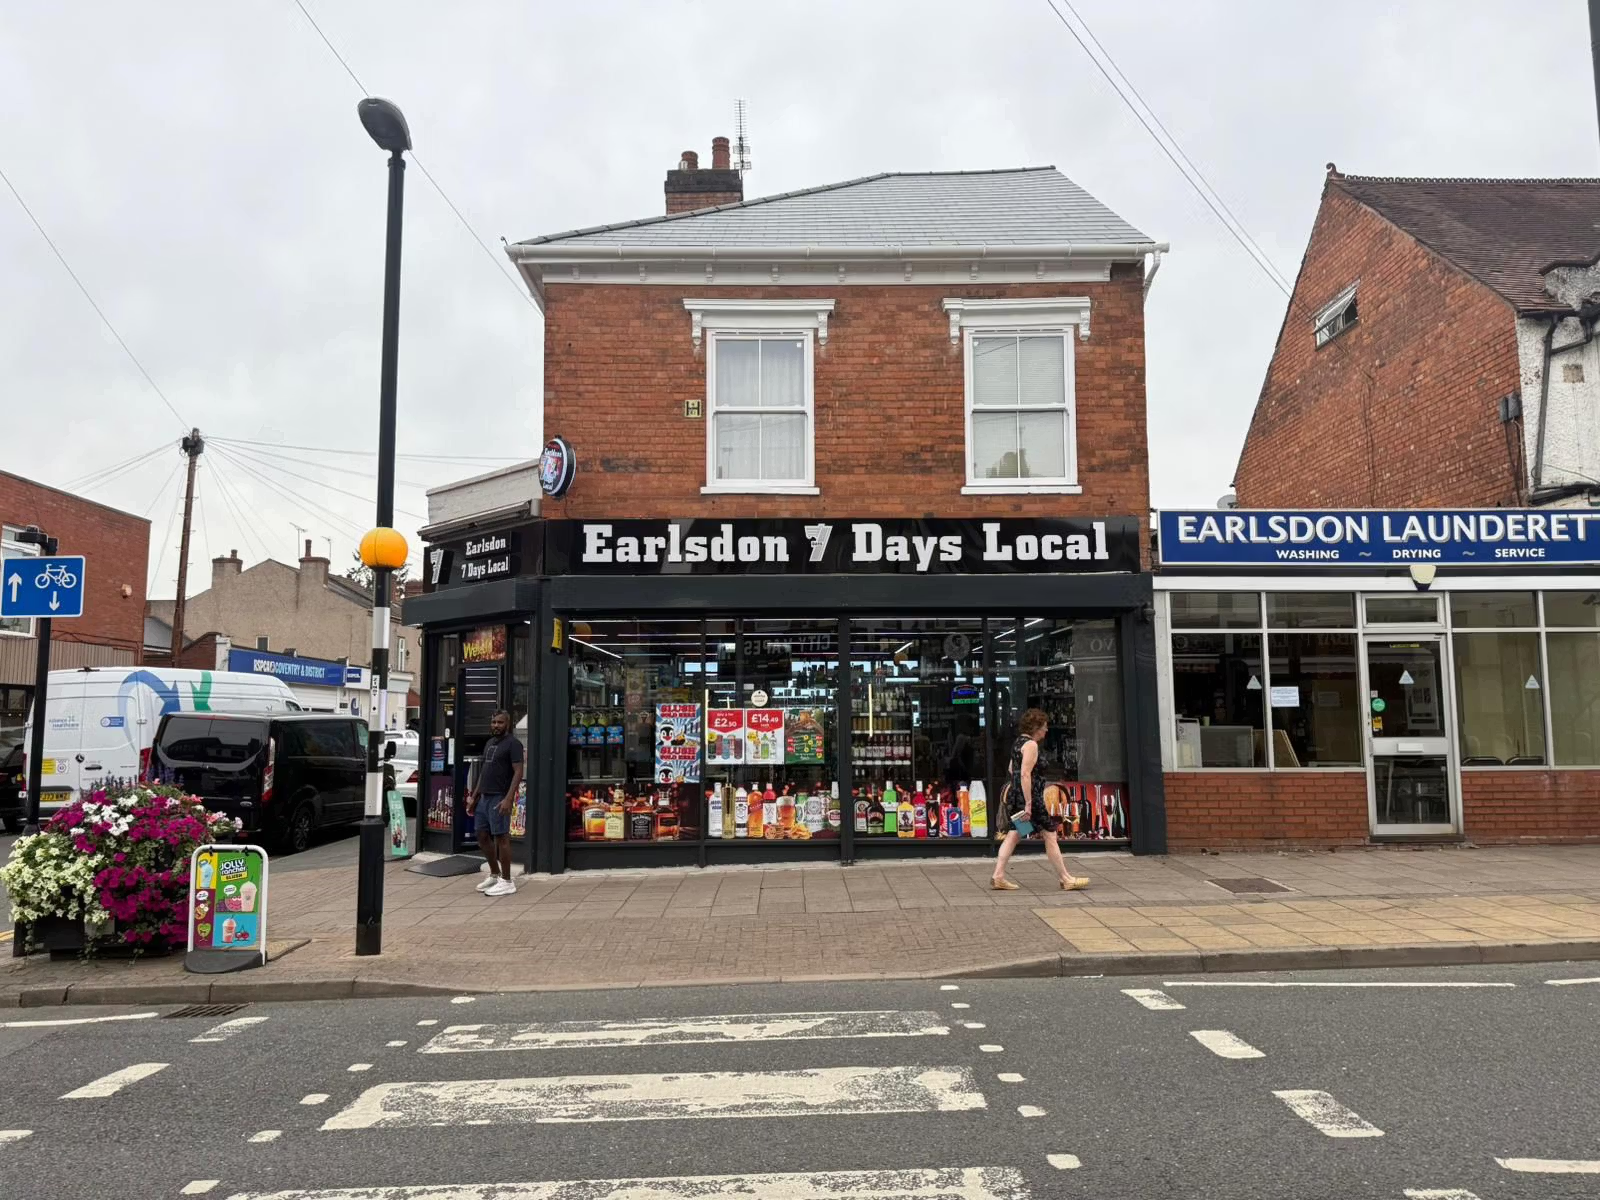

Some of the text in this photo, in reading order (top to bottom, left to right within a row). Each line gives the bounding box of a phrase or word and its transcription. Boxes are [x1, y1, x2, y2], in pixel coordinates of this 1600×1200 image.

[1178, 515, 1370, 543] EARLSDON
[466, 536, 506, 556] Earlsdon
[582, 522, 1109, 572] Earlsdon 7 Days Local
[1275, 547, 1546, 559] WASHING DRYING SERVICE
[461, 556, 509, 579] 7 Days Local
[275, 661, 301, 676] COVENTRY
[306, 667, 325, 678] DISTRICT
[714, 718, 737, 728] £2.50
[752, 713, 779, 723] £14.49
[221, 859, 244, 870] JOLLY
[222, 866, 246, 875] rancher
